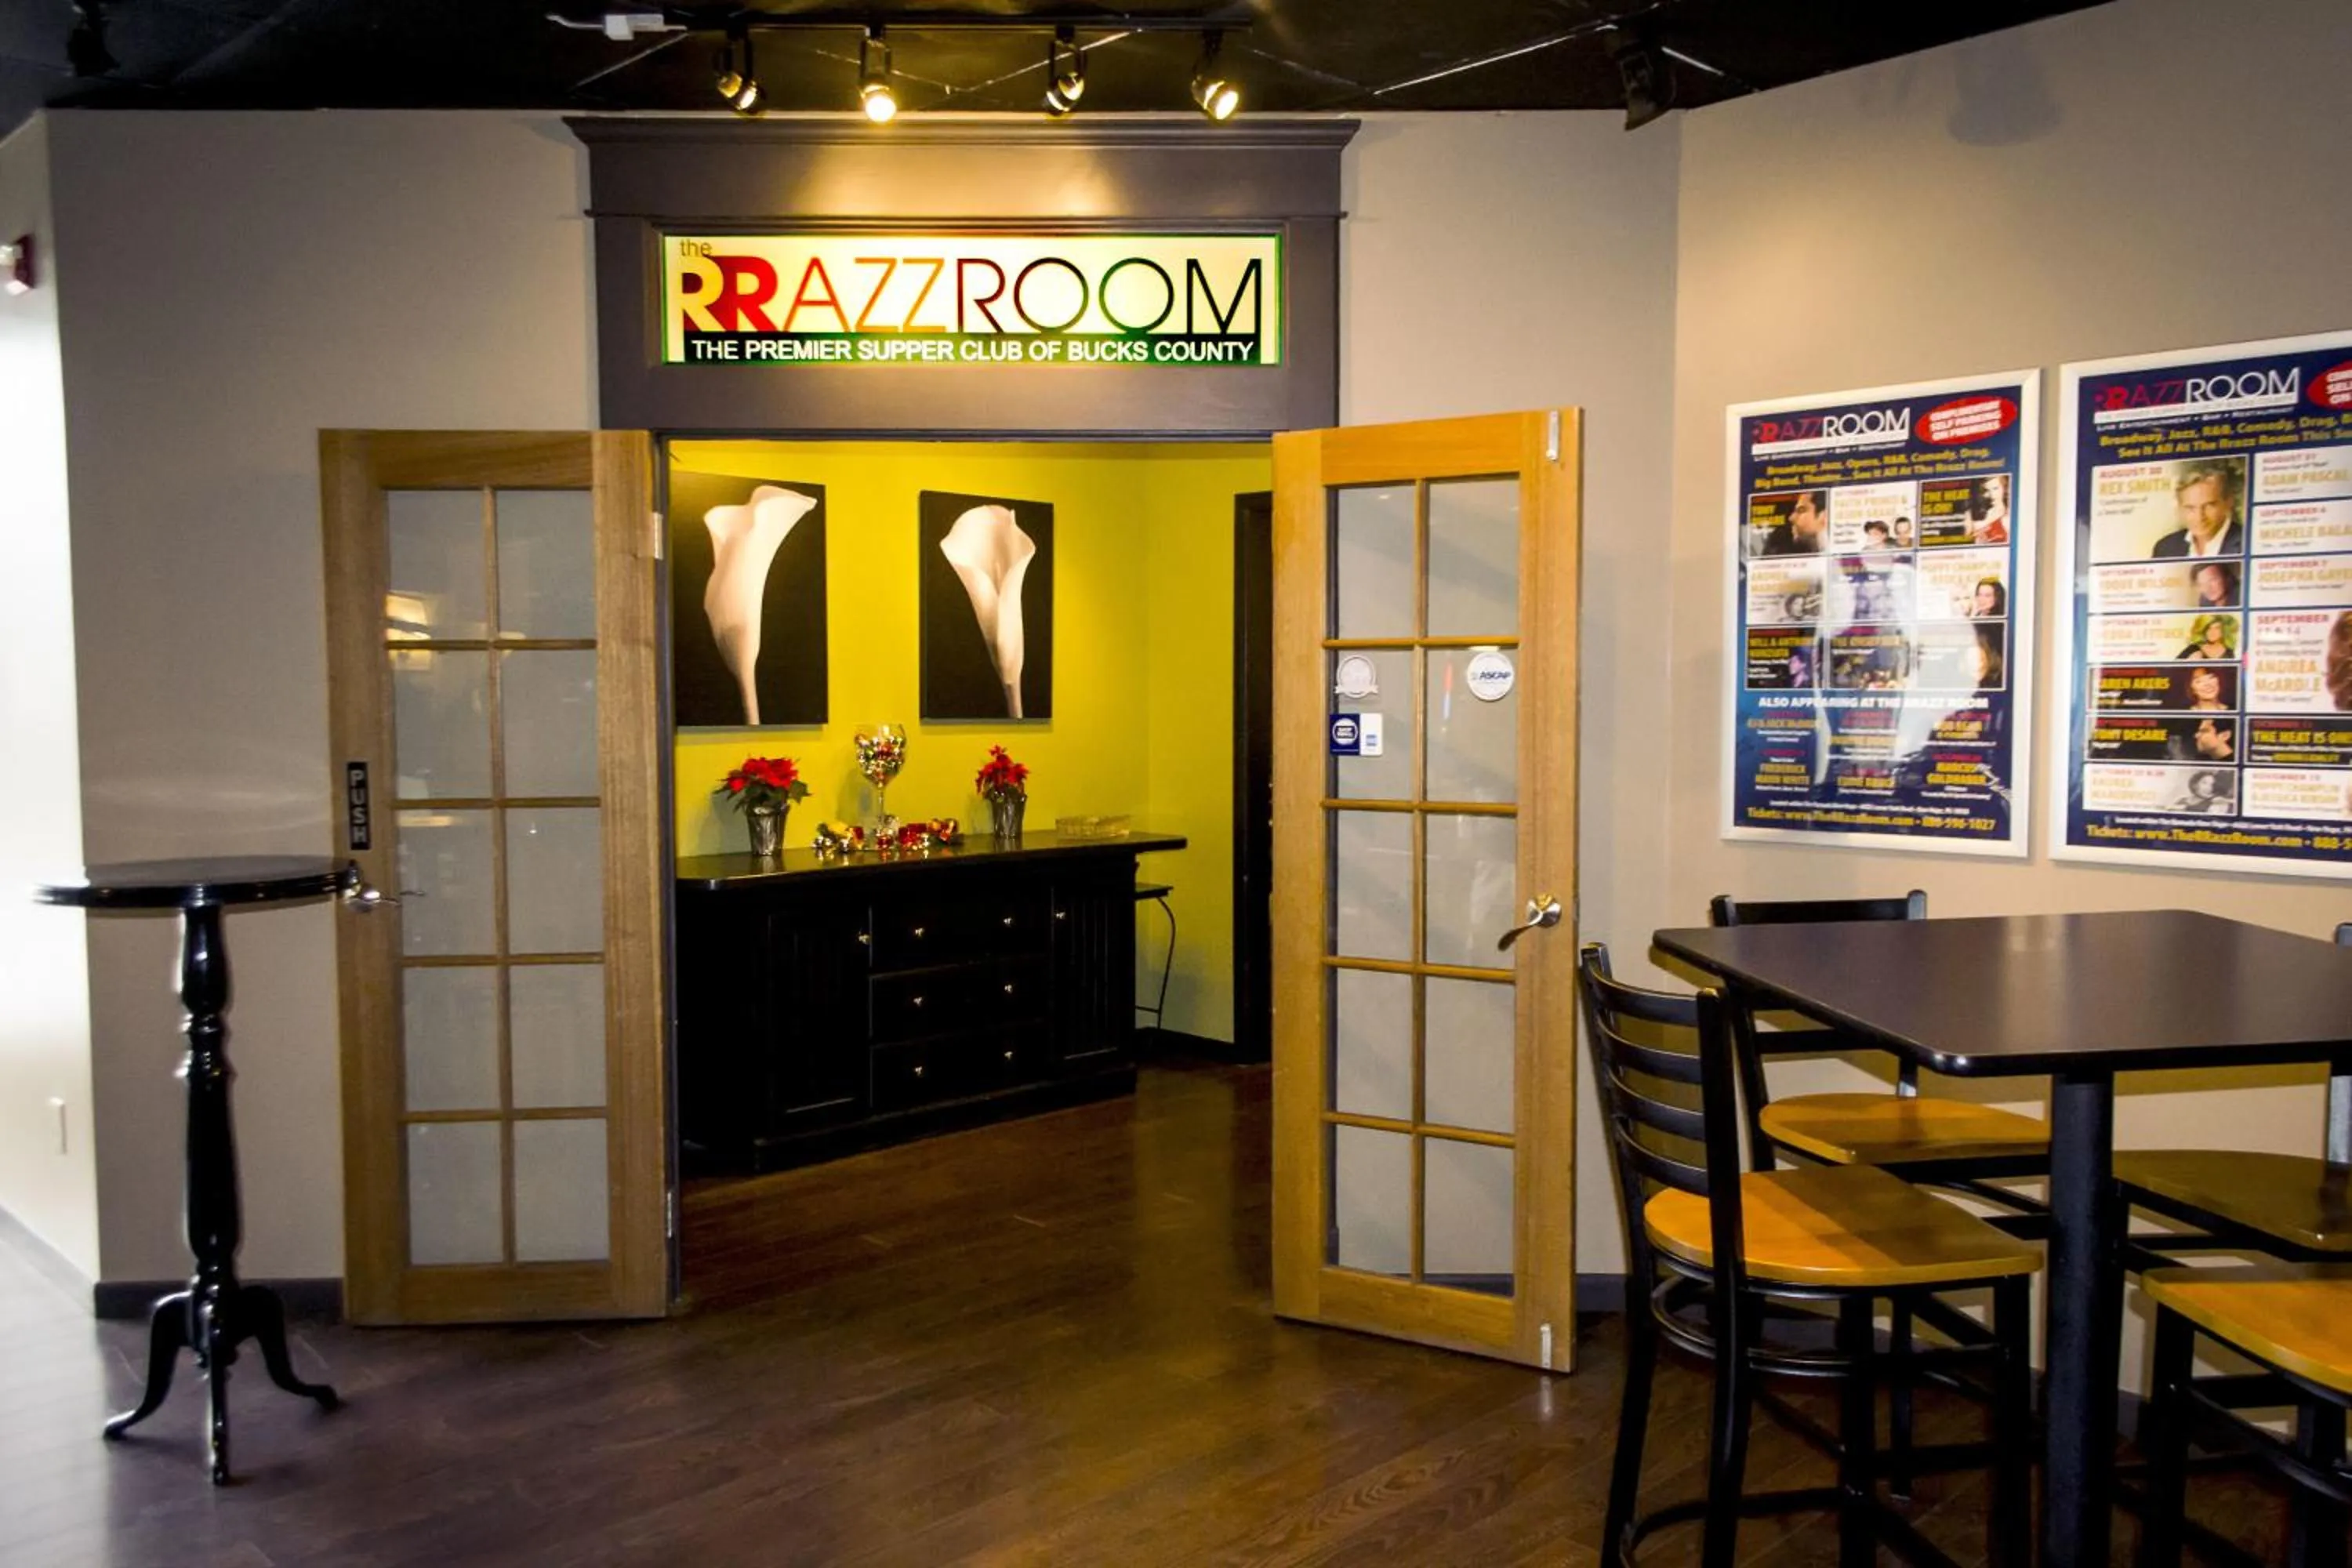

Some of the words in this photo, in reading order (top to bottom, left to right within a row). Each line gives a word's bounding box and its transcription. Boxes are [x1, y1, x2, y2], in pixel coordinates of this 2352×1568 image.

[680, 239, 713, 257] the
[691, 339, 740, 361] THE
[744, 339, 853, 361] PREMIER
[856, 339, 955, 361] SUPPER
[960, 339, 1022, 361] CLUB
[1029, 339, 1062, 361] OF
[1067, 339, 1148, 361] BUCKS
[1153, 339, 1254, 361] COUNTY
[2258, 614, 2329, 624] SEPTEMBER
[350, 769, 368, 844] PUSH
